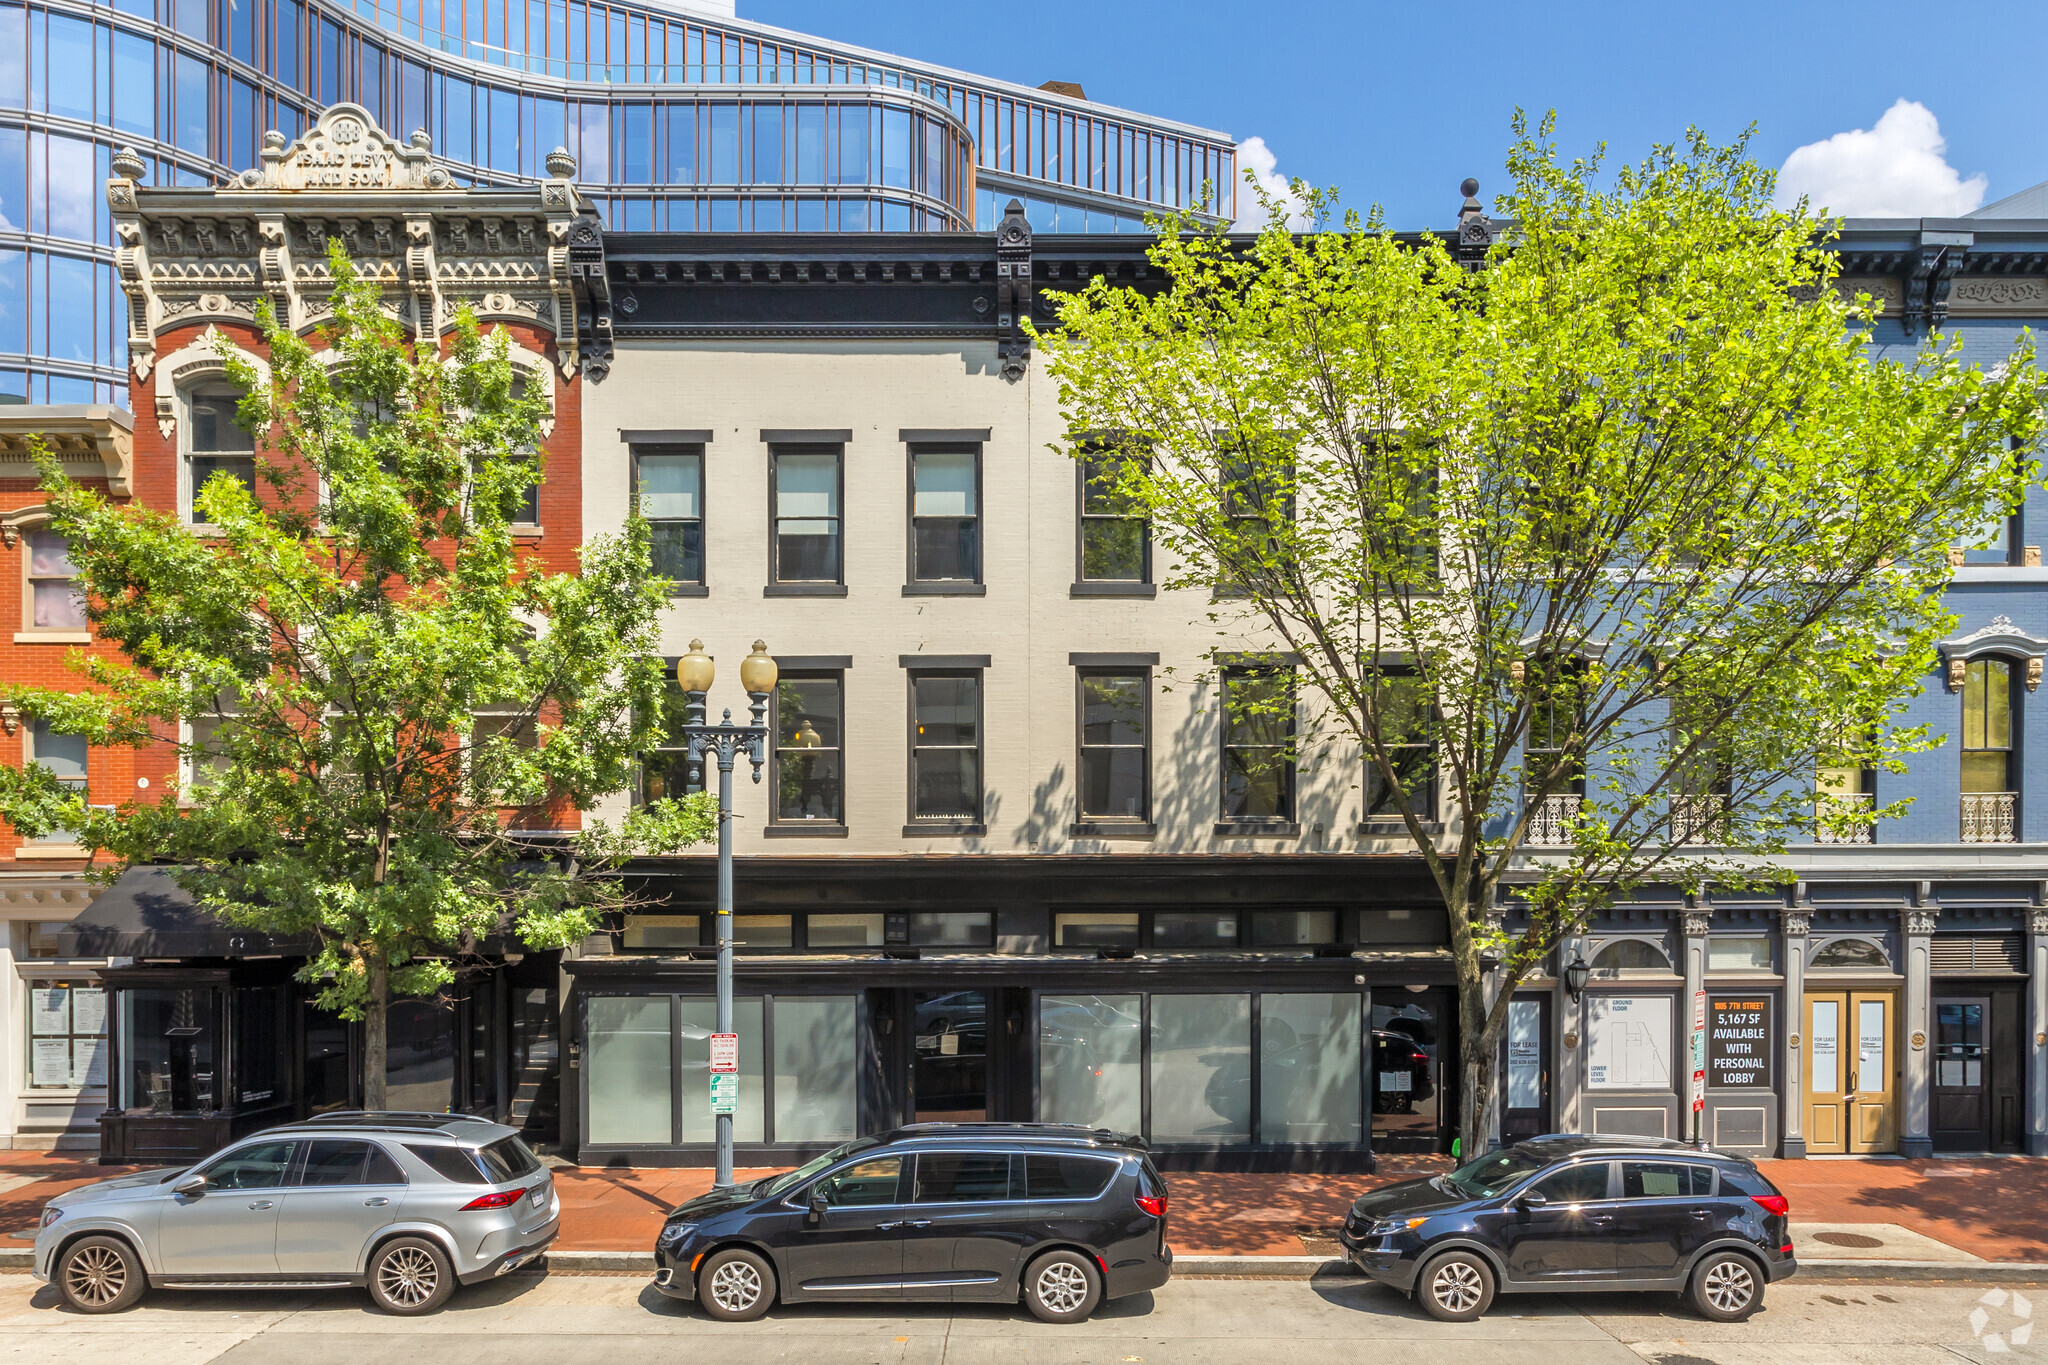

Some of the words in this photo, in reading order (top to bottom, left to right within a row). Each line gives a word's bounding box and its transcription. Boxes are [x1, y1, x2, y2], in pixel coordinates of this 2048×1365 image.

[296, 153, 345, 168] ISAAC
[350, 153, 393, 168] LEVY
[305, 172, 342, 187] AND
[1714, 1002, 1727, 1010] 1005
[1729, 1002, 1741, 1010] 7TH
[1742, 1002, 1765, 1010] STREET
[1718, 1013, 1746, 1026] 5,167
[1748, 1013, 1761, 1024] SF
[1713, 1028, 1765, 1039] AVAILABLE
[1726, 1043, 1752, 1054] WITH
[1714, 1058, 1765, 1069] PERSONAL
[1723, 1073, 1755, 1084] LOBBY
